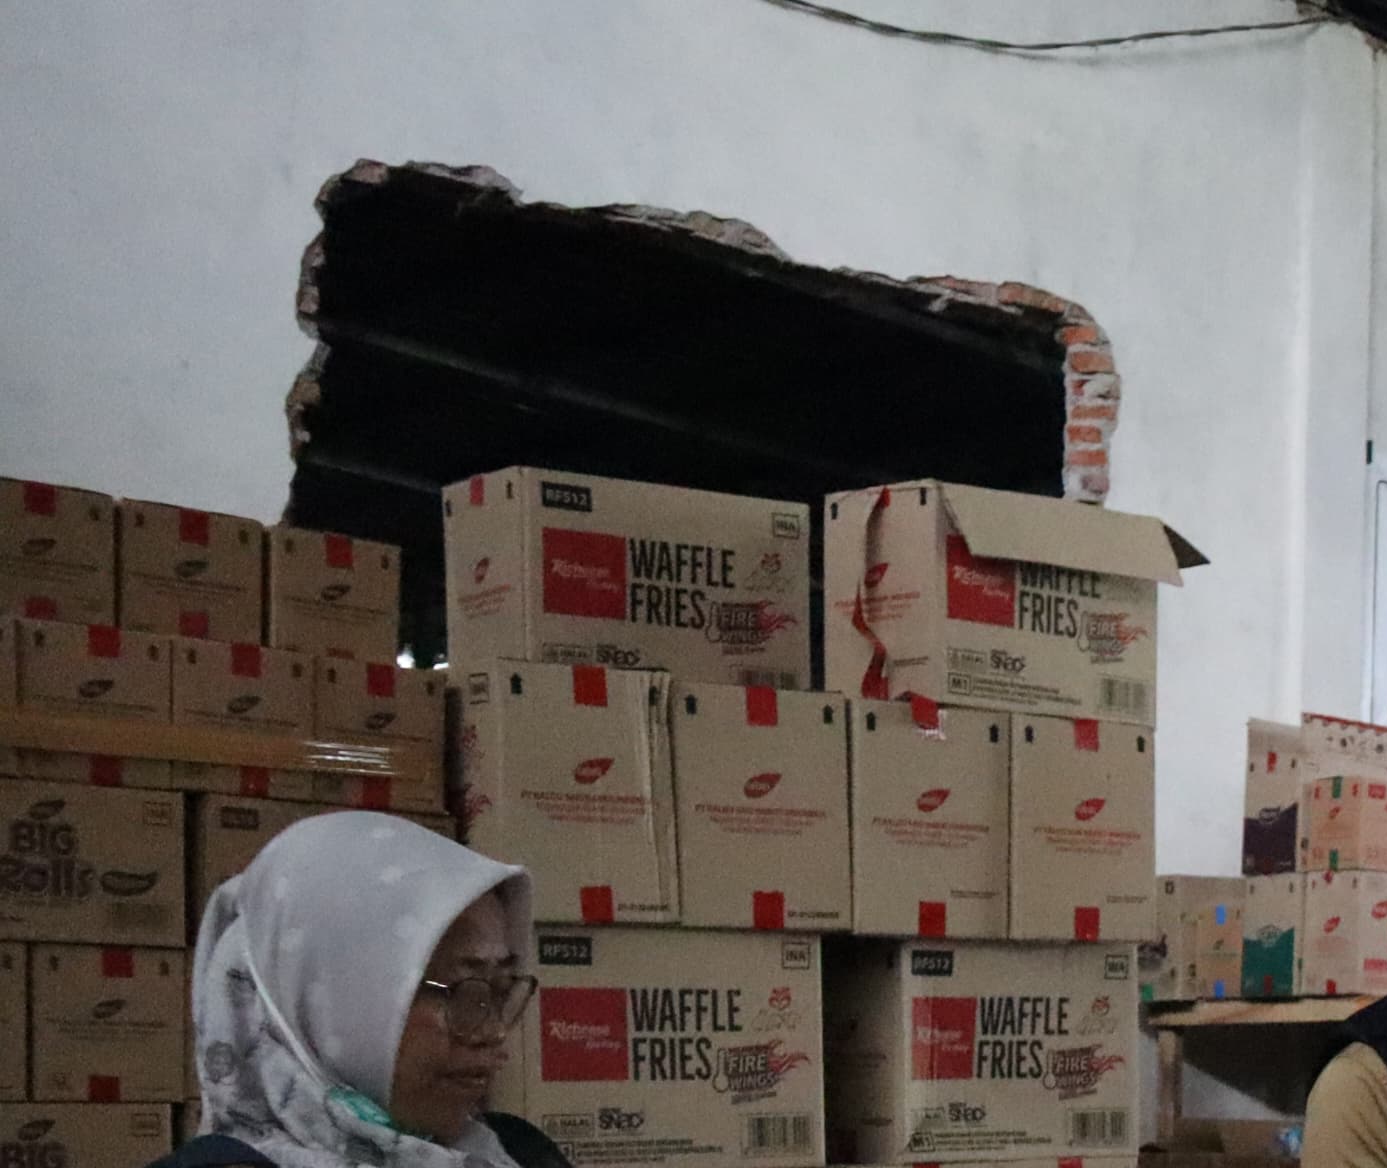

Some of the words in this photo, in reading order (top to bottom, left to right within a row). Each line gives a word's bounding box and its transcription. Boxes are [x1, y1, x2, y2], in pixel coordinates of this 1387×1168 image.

[630, 538, 736, 588] WAFFLE
[630, 583, 706, 630] FRIES
[1018, 591, 1079, 639] FRIES
[10, 819, 80, 857] BIG
[630, 987, 742, 1032] WAFFLE
[980, 996, 1069, 1036] WAFFLE
[632, 1037, 713, 1081] FRIES
[728, 1055, 766, 1073] FIRE
[976, 1040, 1043, 1080] FRIES
[1056, 1056, 1090, 1073] FIRE
[730, 1072, 775, 1090] WINGS
